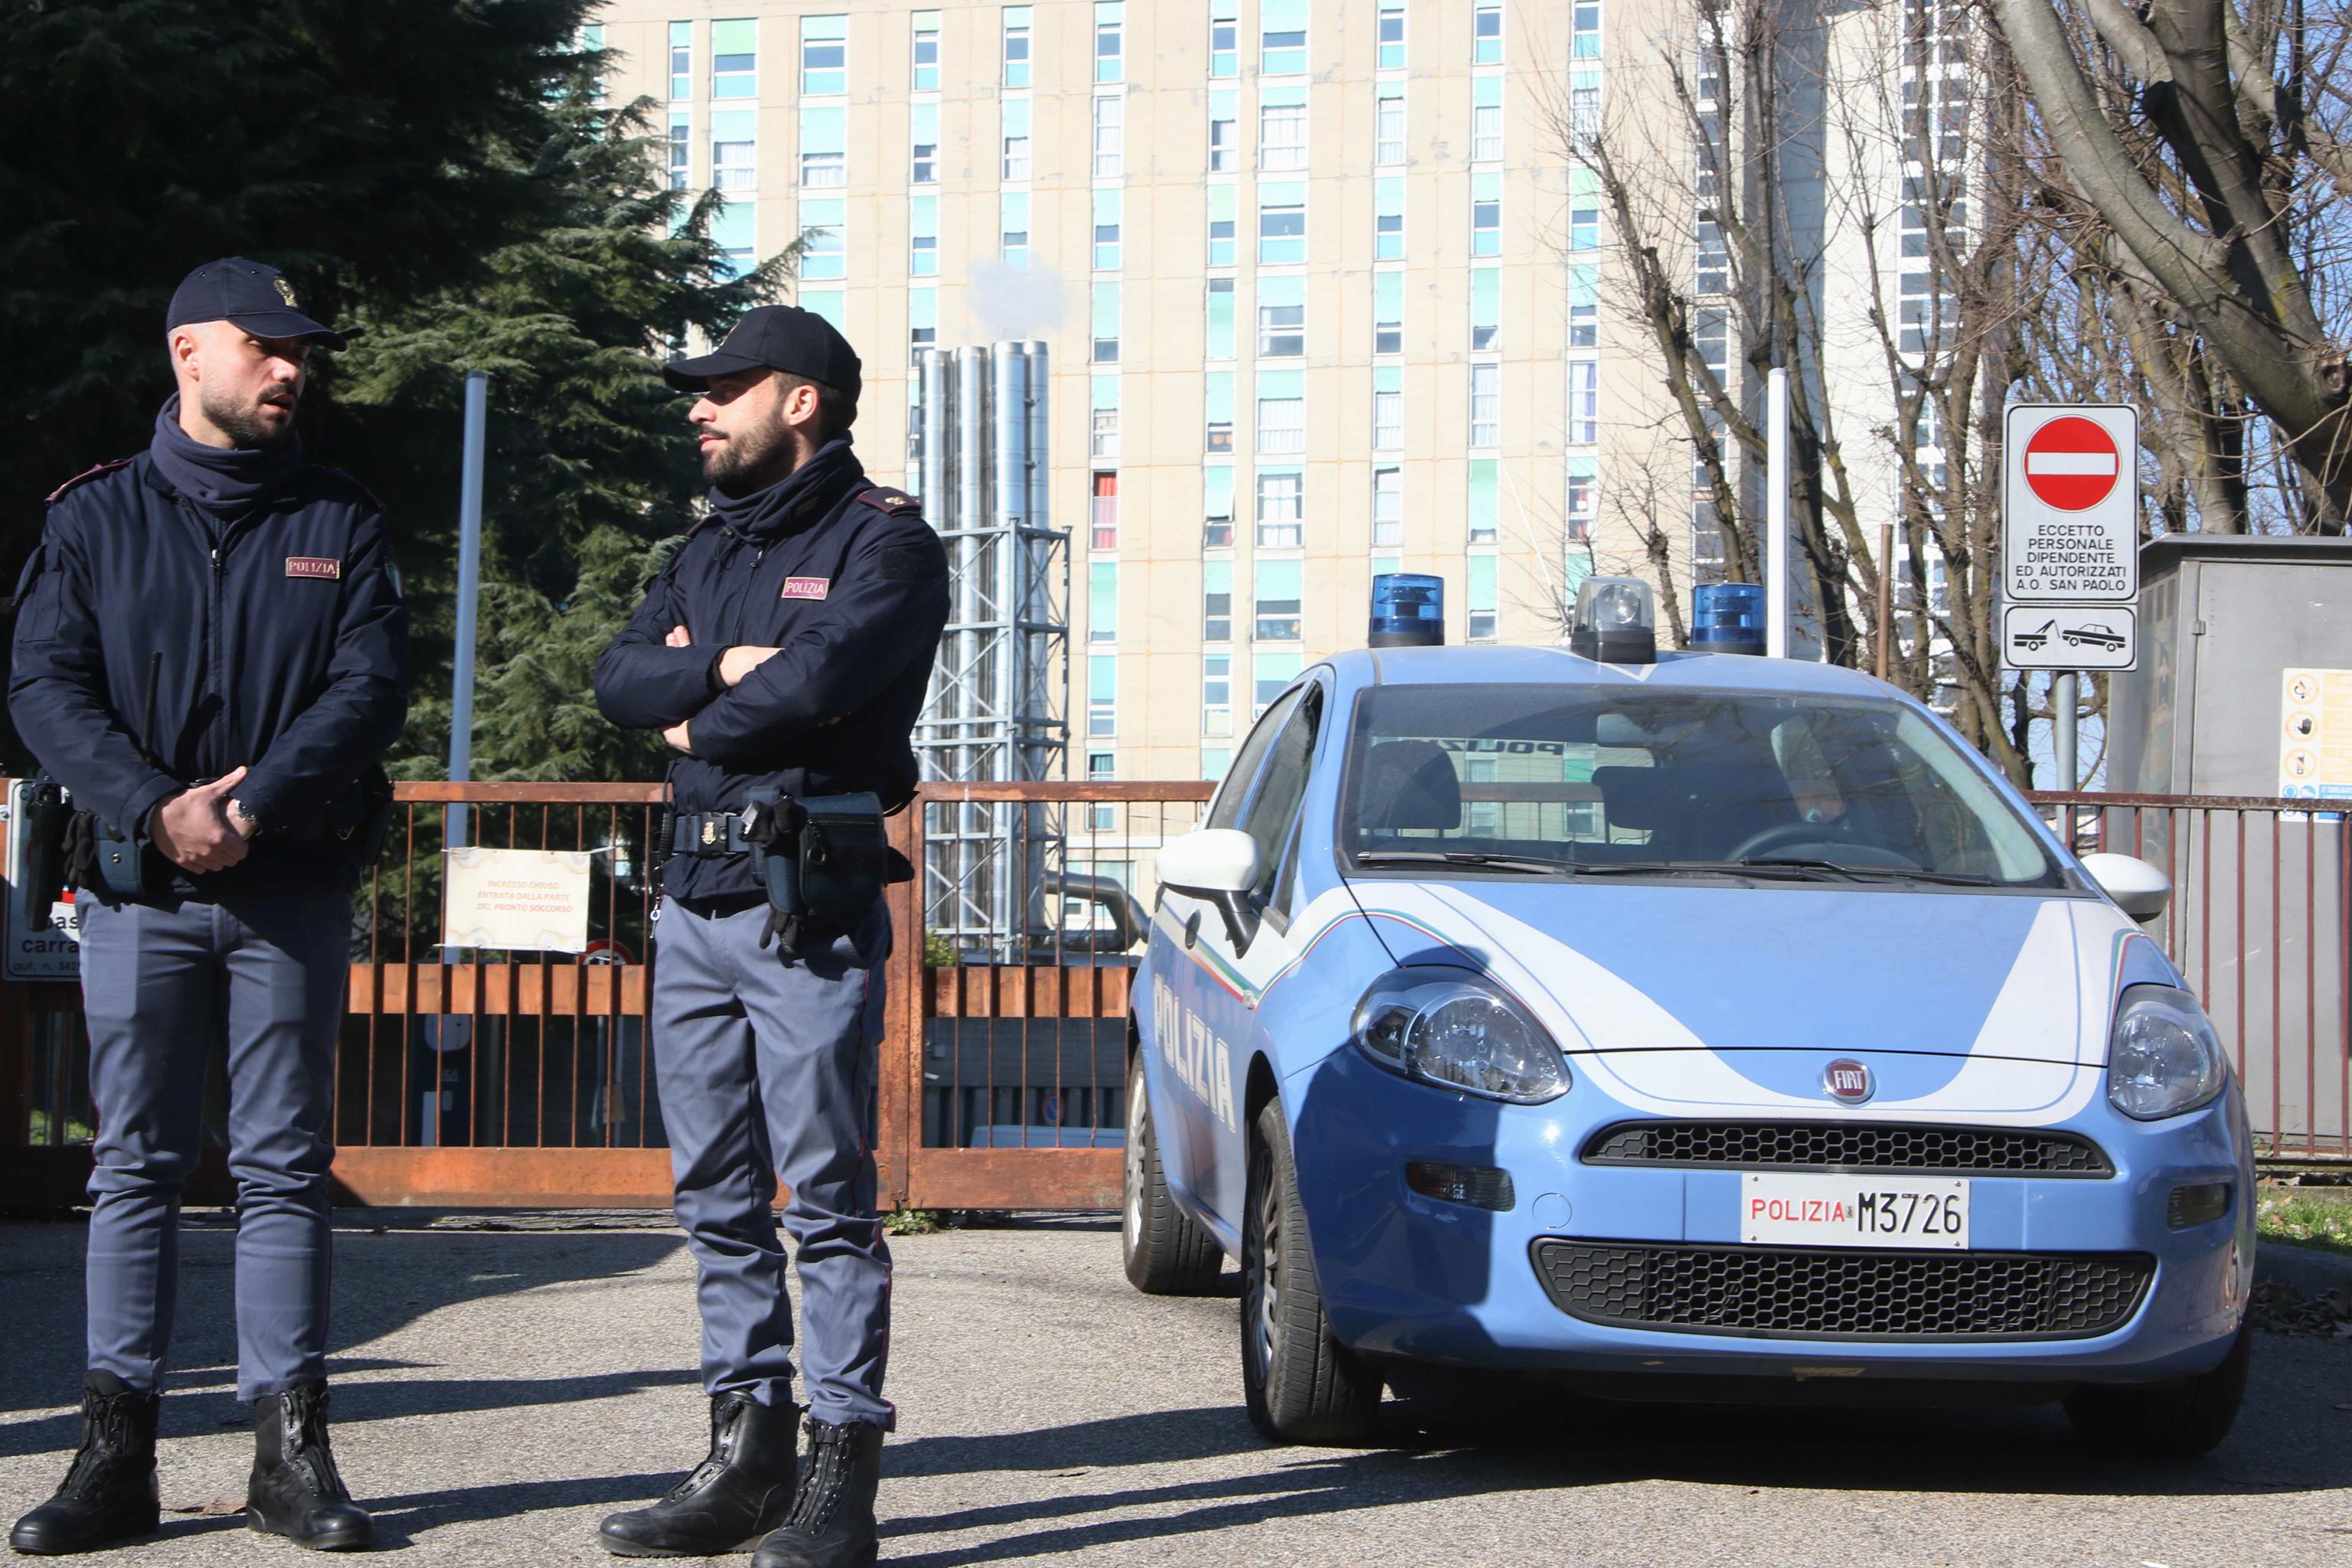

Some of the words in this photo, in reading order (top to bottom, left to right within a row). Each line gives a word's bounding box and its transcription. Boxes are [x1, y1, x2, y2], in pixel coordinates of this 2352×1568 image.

[2038, 524, 2105, 537] ECCETTO
[2028, 538, 2114, 550] PERSONALE
[2027, 552, 2115, 564] DIPENDENTE
[289, 561, 335, 574] POLIZIA
[2016, 566, 2034, 577] ED
[2040, 566, 2126, 578] AUTORIZZATI
[786, 582, 825, 594] POLIZIA
[2016, 579, 2042, 590] A.O.
[2049, 579, 2077, 590] SAN
[2082, 580, 2126, 591] PAOLO
[488, 880, 528, 889] INGRESSO
[529, 904, 573, 913] SOCCORSO
[21, 939, 79, 953] carra
[1154, 973, 1236, 1133] POLIZIA
[1834, 1070, 1863, 1090] FIAT
[1751, 1198, 1845, 1222] POLIZIA
[1857, 1193, 1962, 1233] M3726
